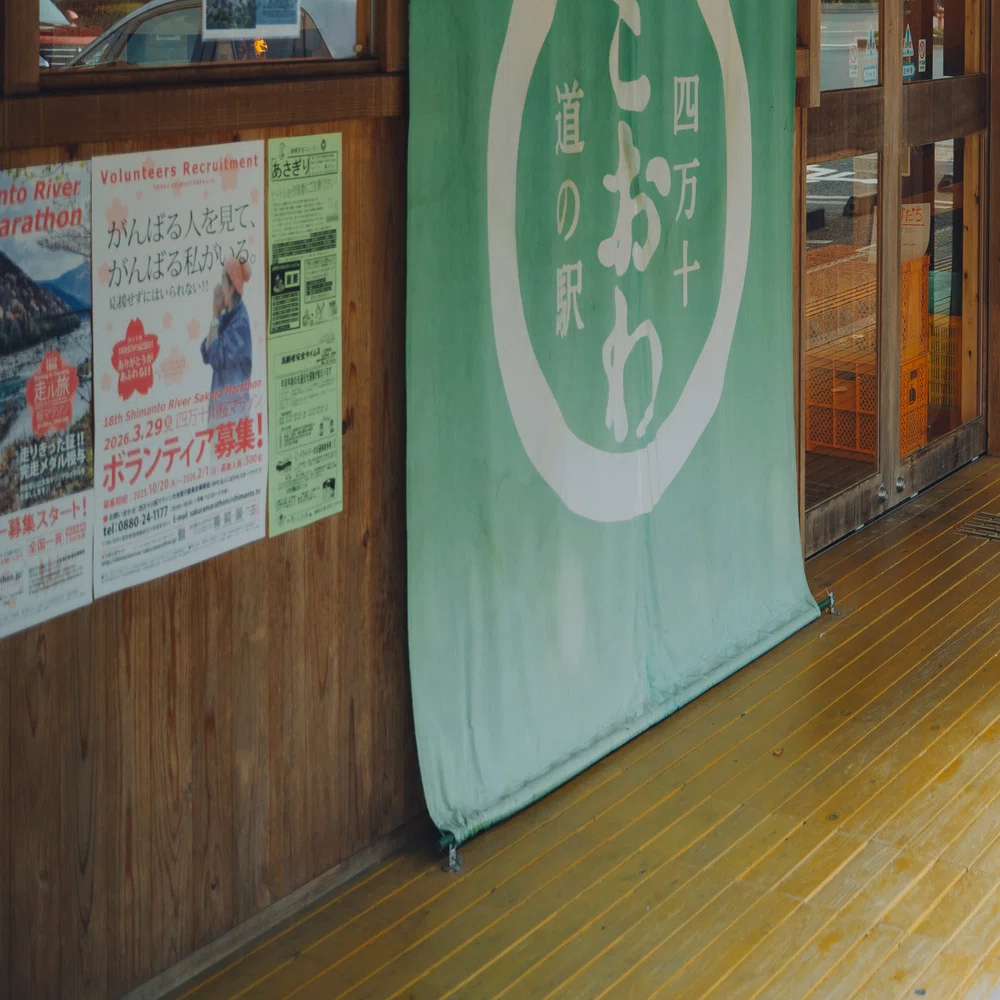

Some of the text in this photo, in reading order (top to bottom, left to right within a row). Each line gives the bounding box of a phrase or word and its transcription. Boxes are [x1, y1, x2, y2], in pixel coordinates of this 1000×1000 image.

[34, 177, 82, 202] River
[100, 164, 177, 185] Volunteers
[183, 154, 259, 176] Recruitment
[271, 158, 310, 178] あさぎり
[555, 80, 585, 340] 道の駅
[673, 75, 701, 308] 四万十
[107, 203, 255, 249] がんばる人を見て、
[108, 239, 257, 289] がんばる私がいる。
[103, 379, 261, 428] 18th Shimanto River Sakura Marathon
[102, 411, 263, 492] ボランティア募集!
[103, 417, 163, 452] 2026.3.29
[103, 505, 169, 537] tel:0880-24-1177
